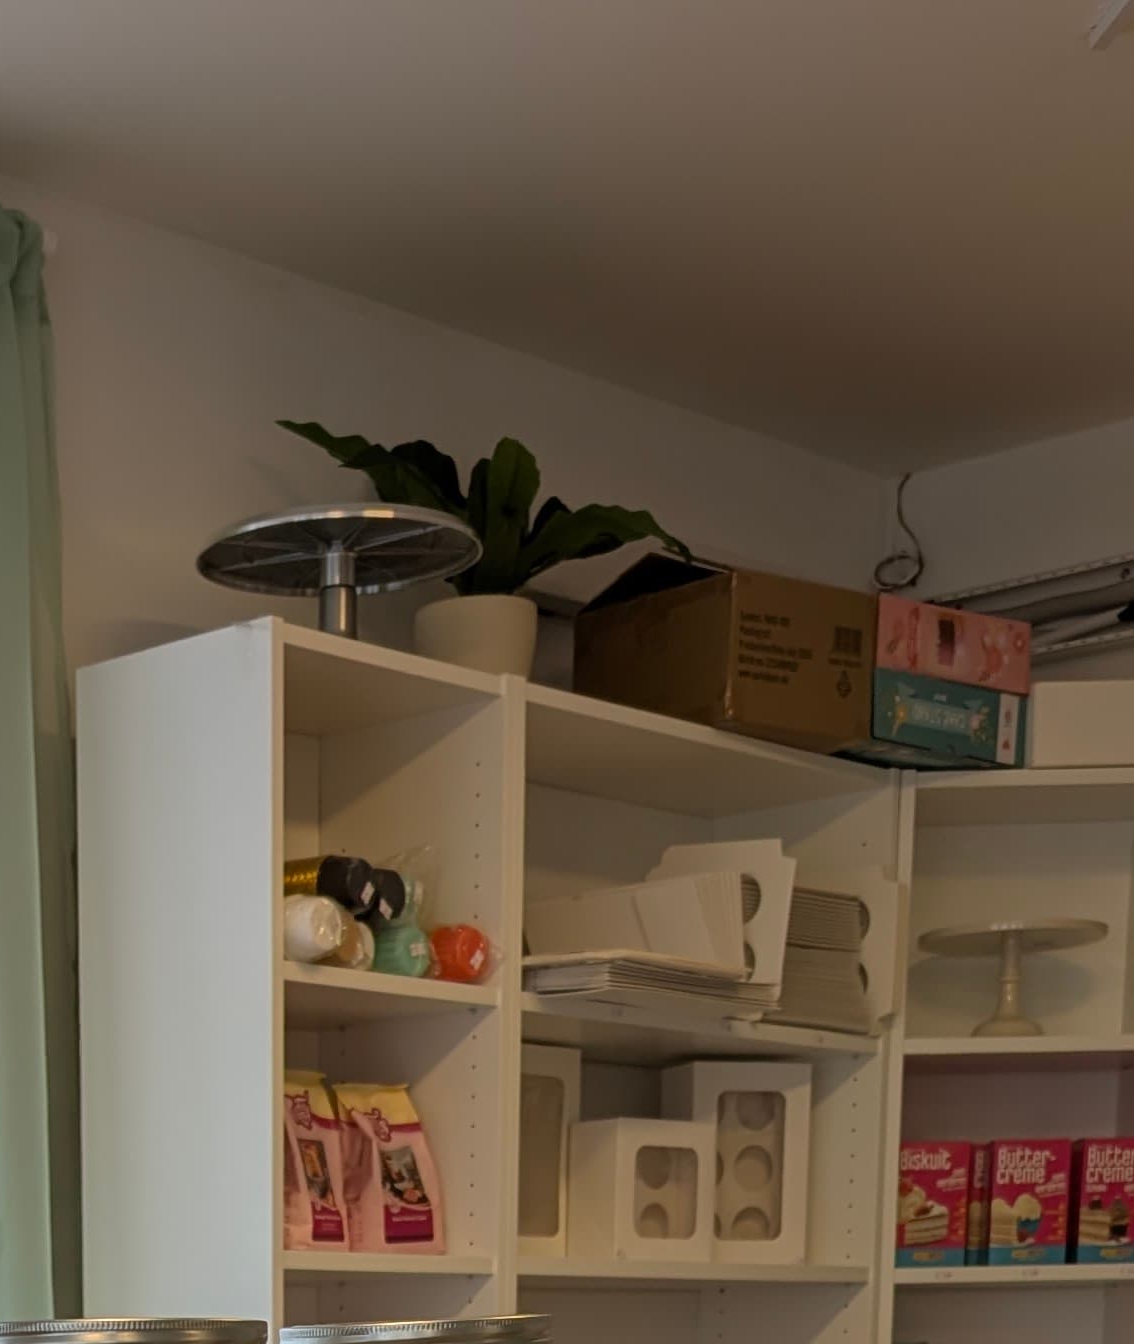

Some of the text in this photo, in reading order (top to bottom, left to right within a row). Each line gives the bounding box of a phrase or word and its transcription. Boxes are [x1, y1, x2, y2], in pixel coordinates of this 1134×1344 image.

[900, 1146, 952, 1170] Biskuit
[997, 1145, 1057, 1169] Butter-
[996, 1167, 1046, 1185] creme
[1086, 1167, 1134, 1185] creme
